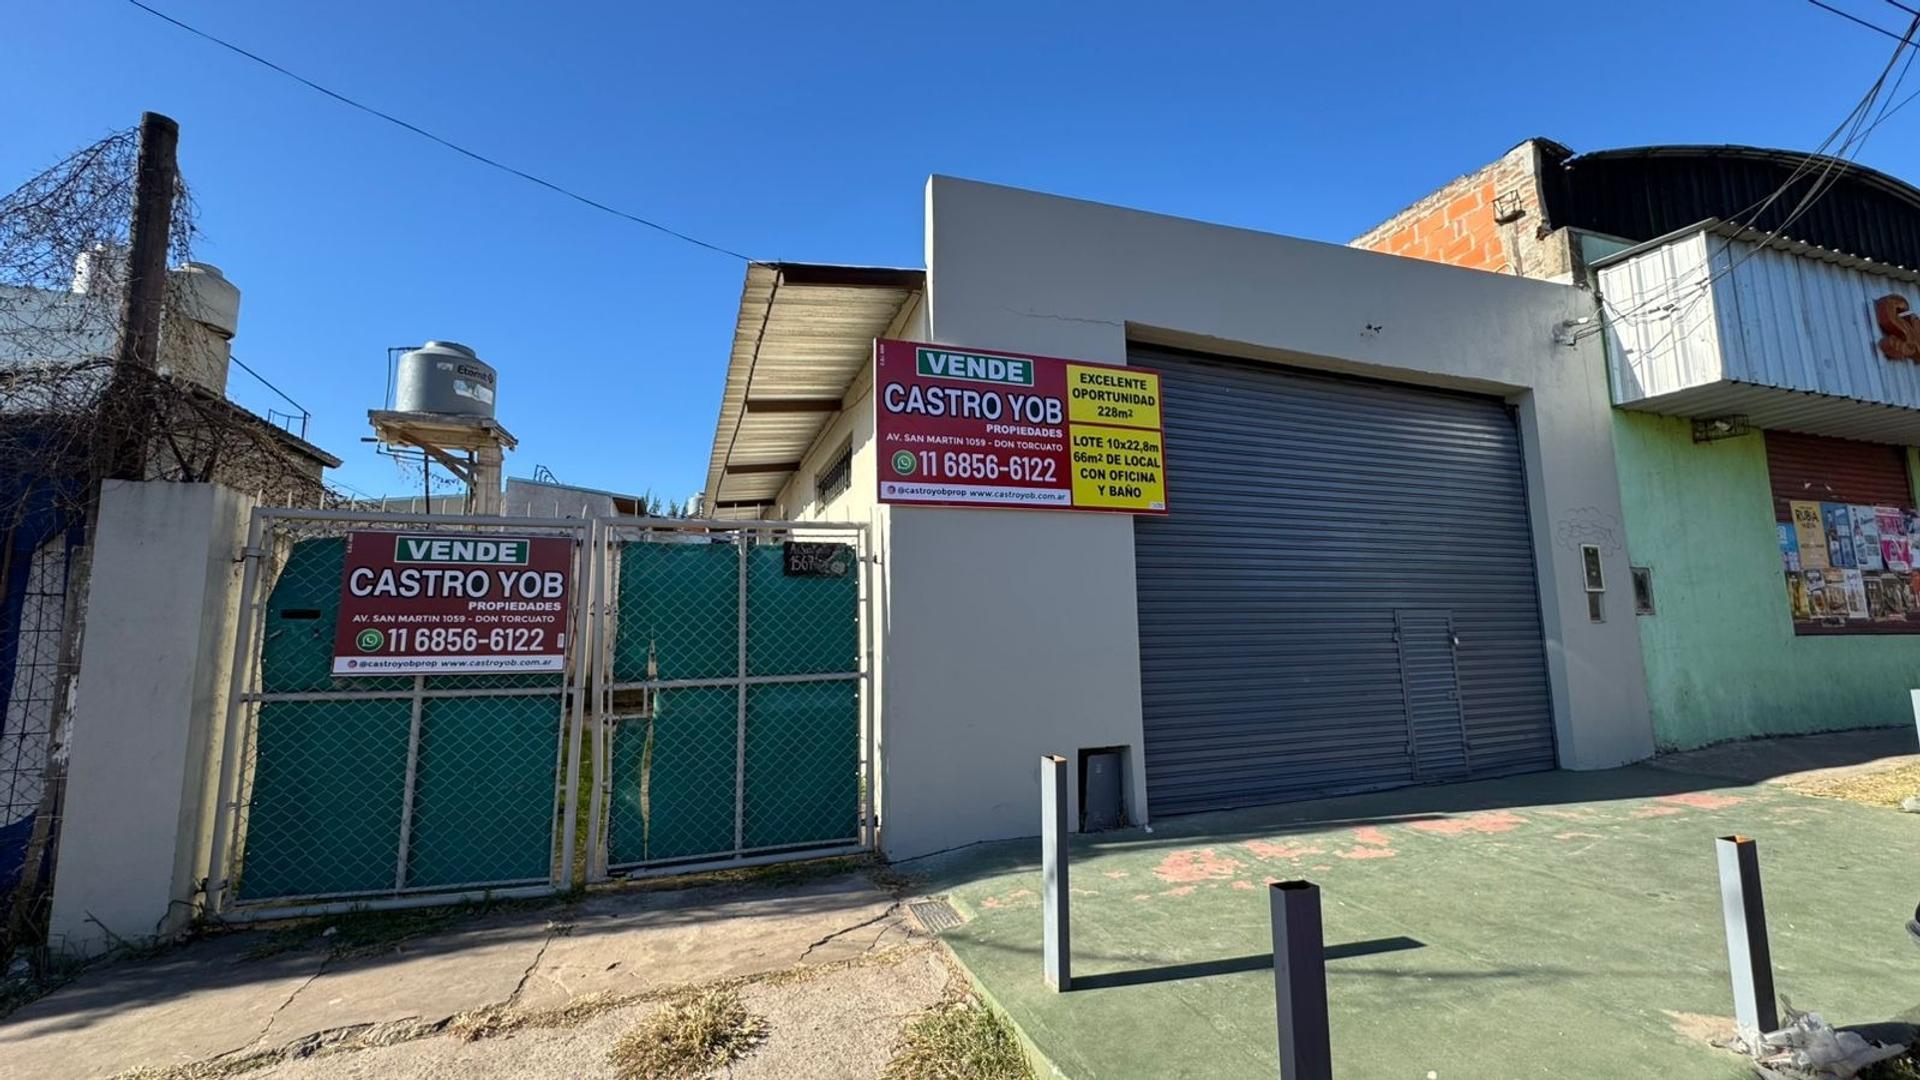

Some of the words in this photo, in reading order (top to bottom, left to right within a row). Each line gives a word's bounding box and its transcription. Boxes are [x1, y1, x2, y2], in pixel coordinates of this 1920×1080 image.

[925, 352, 1025, 382] VENDE
[1080, 373, 1147, 390] EXCELENTE
[884, 383, 1001, 420] CASTRO
[1007, 394, 1063, 424] YOB
[1072, 387, 1155, 406] OPORTUNIDAD
[986, 424, 1063, 438] PROPIEDADES
[886, 433, 902, 442] AV.
[904, 434, 924, 443] SAN
[926, 435, 963, 445] MARTIN
[965, 437, 986, 447] 1059
[994, 440, 1014, 449] DON
[1016, 441, 1063, 451] TORCUATO
[1073, 436, 1103, 448] LOTE
[1107, 438, 1159, 453] 10x22,8m
[919, 451, 937, 477] 11
[944, 452, 1057, 482] 6856-6122
[1106, 454, 1121, 465] DE
[1125, 455, 1160, 468] LOCAL
[1080, 468, 1106, 480] CON
[1109, 470, 1156, 483] OFICINA
[898, 485, 967, 496] @castroyobprop
[969, 490, 1066, 500] www.castroyob.com.ar
[1098, 485, 1105, 496] Y
[1109, 484, 1142, 498] BAÑO
[407, 540, 518, 561] VENDE
[350, 567, 490, 598] CASTRO
[499, 571, 564, 599] YOB
[468, 601, 561, 611] PROPIEDADES
[352, 615, 370, 623] AV.
[372, 615, 397, 623] SAN
[398, 615, 440, 623] MARTIN
[442, 615, 465, 623] 1059
[475, 615, 499, 623] DON
[501, 615, 555, 623] TORCUATO
[388, 628, 408, 652] 11
[414, 628, 544, 652] 6856-6122
[359, 660, 438, 669] @castroyobprop
[441, 658, 551, 667] www.castroyob.com.ar
